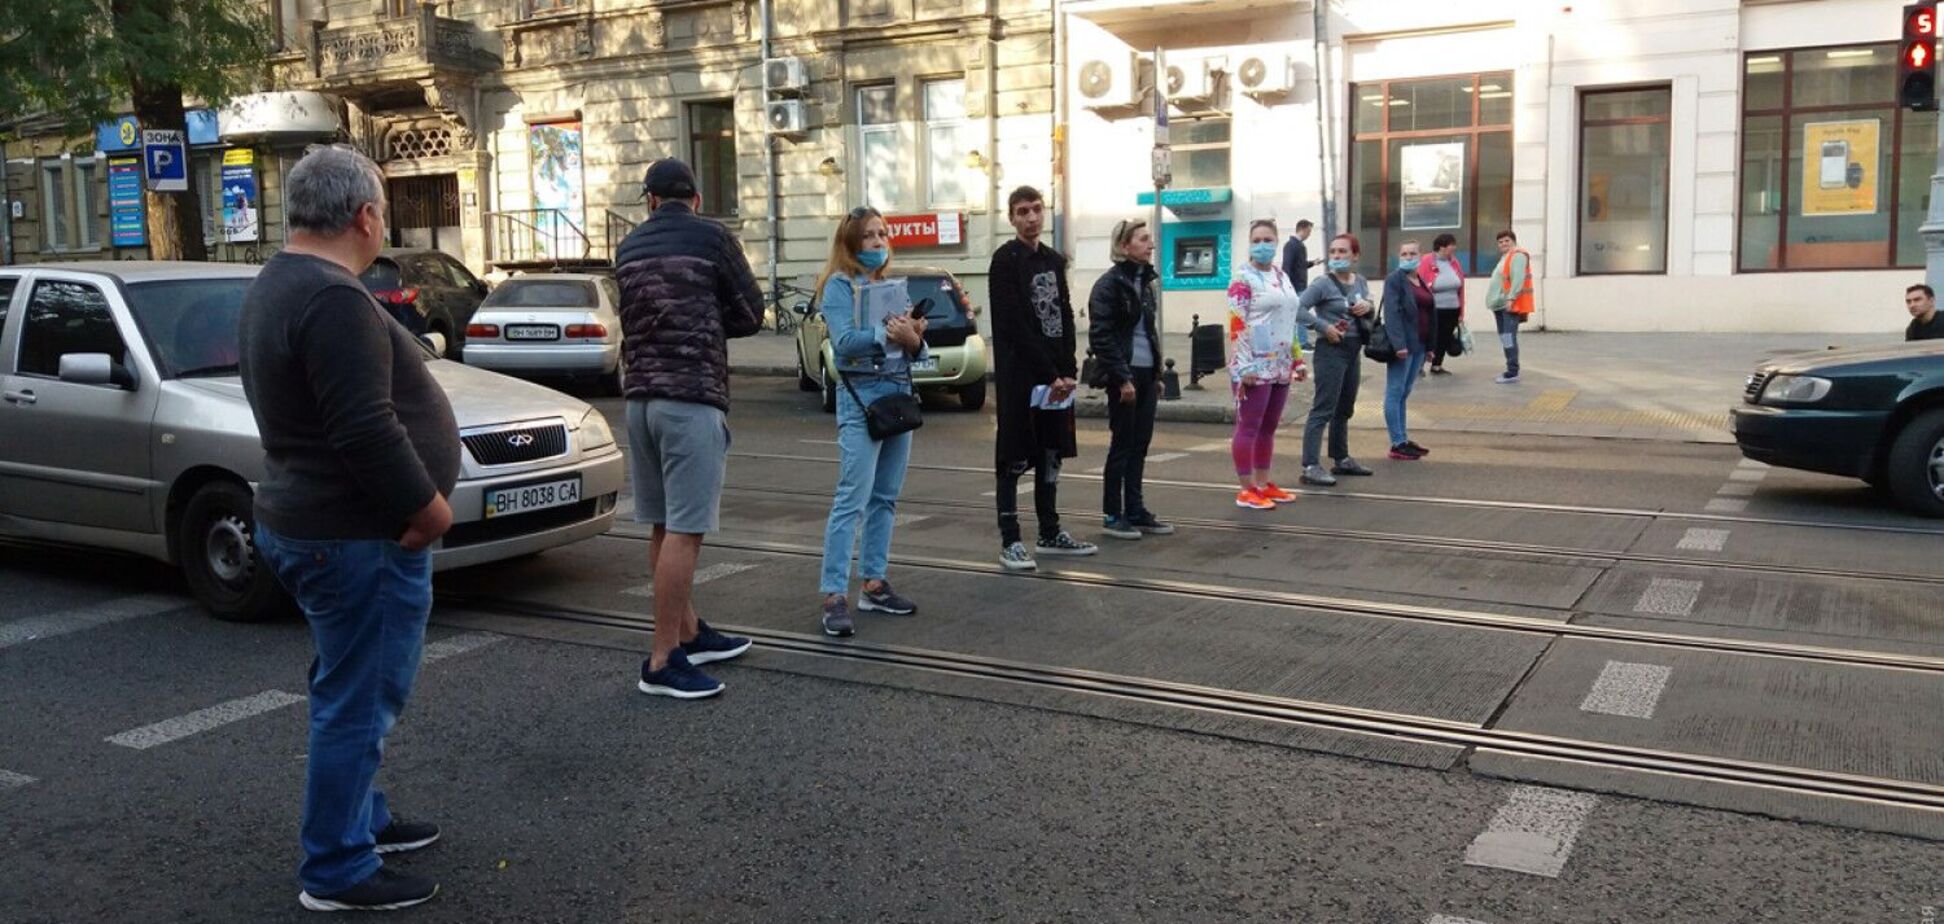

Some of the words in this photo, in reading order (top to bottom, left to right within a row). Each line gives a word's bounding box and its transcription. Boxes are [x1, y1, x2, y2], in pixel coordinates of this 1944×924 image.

[1917, 13, 1932, 33] 5
[146, 131, 181, 144] ЗОНА
[153, 149, 174, 175] P
[496, 491, 518, 513] BH
[521, 486, 554, 508] 8038
[558, 481, 578, 502] CA
